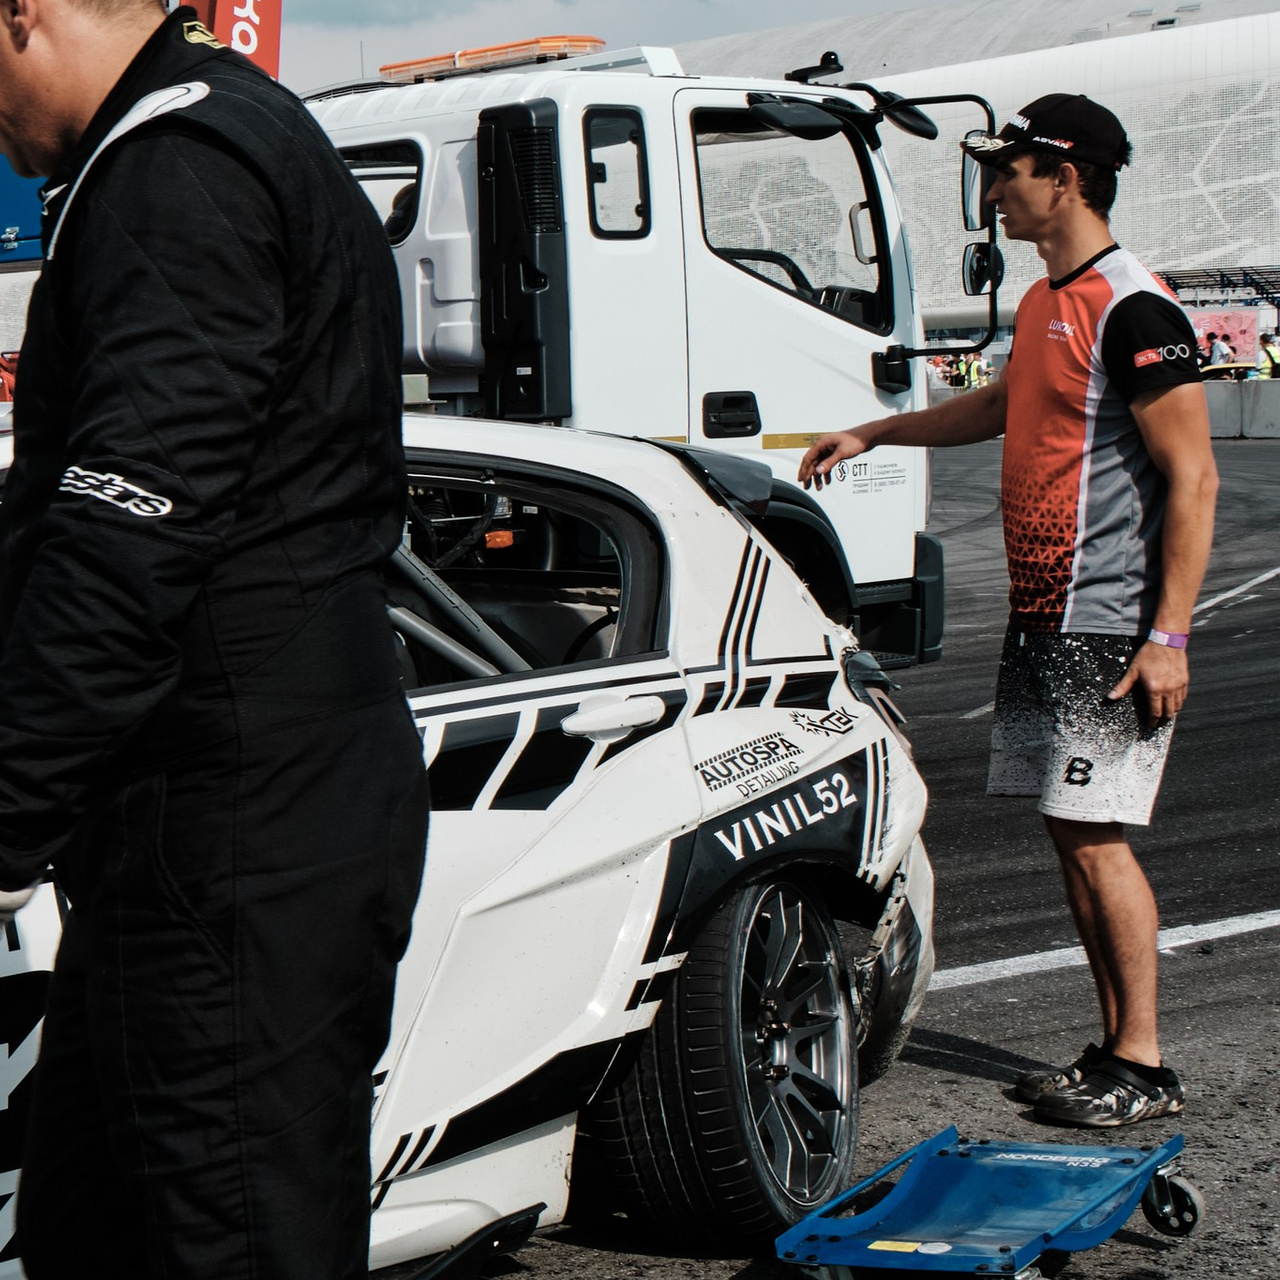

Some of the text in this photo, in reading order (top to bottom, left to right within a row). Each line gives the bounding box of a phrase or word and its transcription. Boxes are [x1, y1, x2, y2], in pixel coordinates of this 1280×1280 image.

[1157, 343, 1190, 362] 100
[700, 737, 799, 787] AUTOSPA
[736, 761, 800, 798] DETAILING
[714, 772, 858, 861] VINIL52
